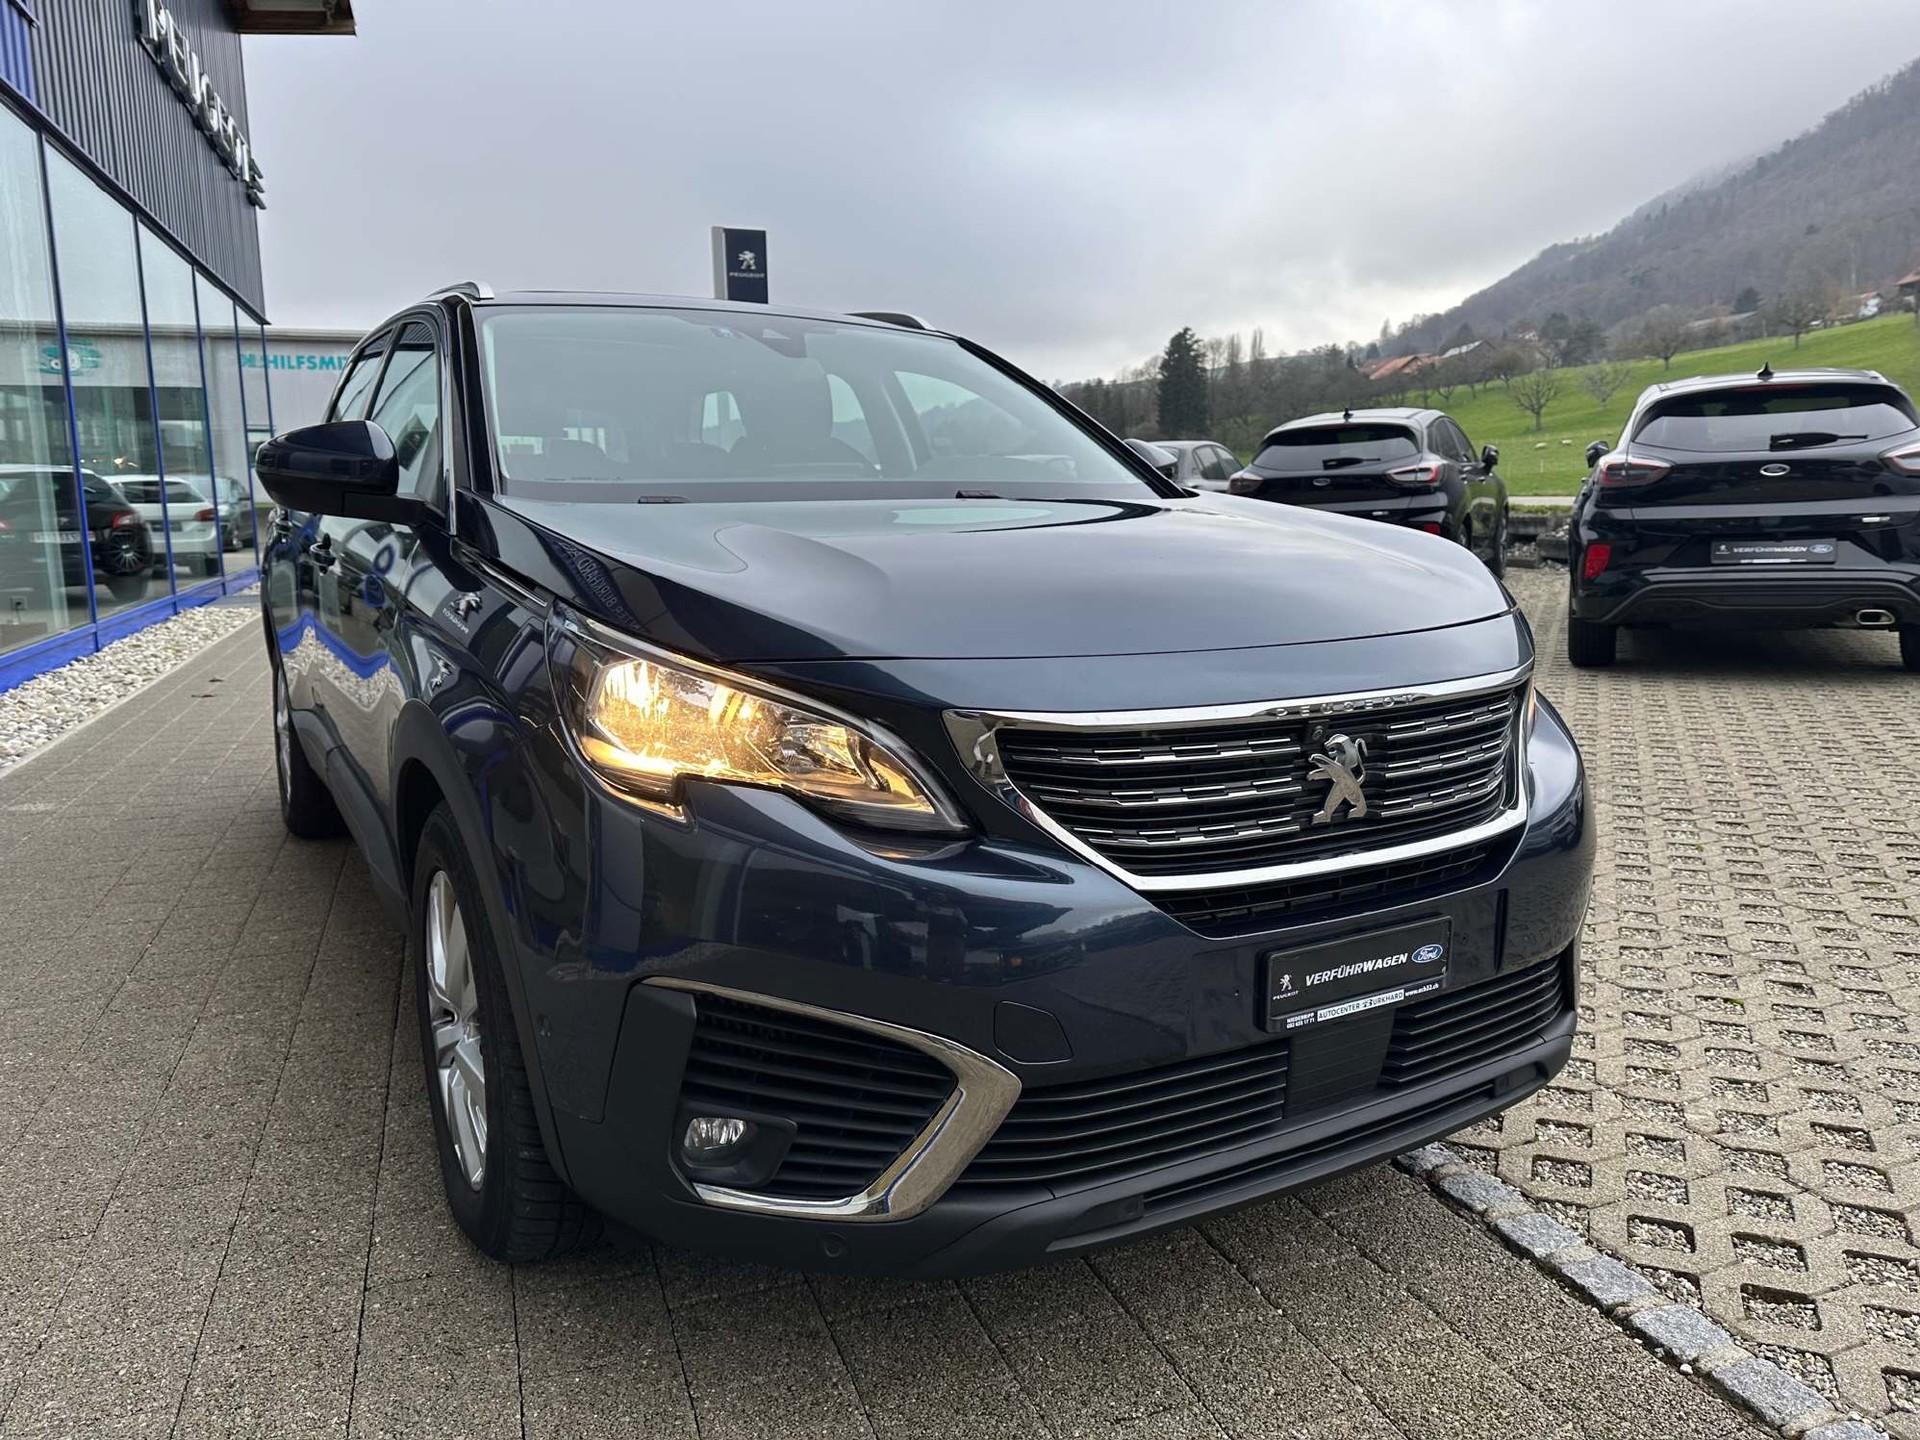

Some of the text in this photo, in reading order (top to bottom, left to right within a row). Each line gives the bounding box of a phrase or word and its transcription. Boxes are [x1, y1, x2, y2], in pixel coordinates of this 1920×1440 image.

[1275, 693, 1413, 719] PEUGEOT
[1305, 946, 1440, 987] VERFÜHRWAGEN Ford
[1273, 990, 1299, 1000] PEUGEOT
[1318, 1003, 1360, 1019] AUTOCENTER
